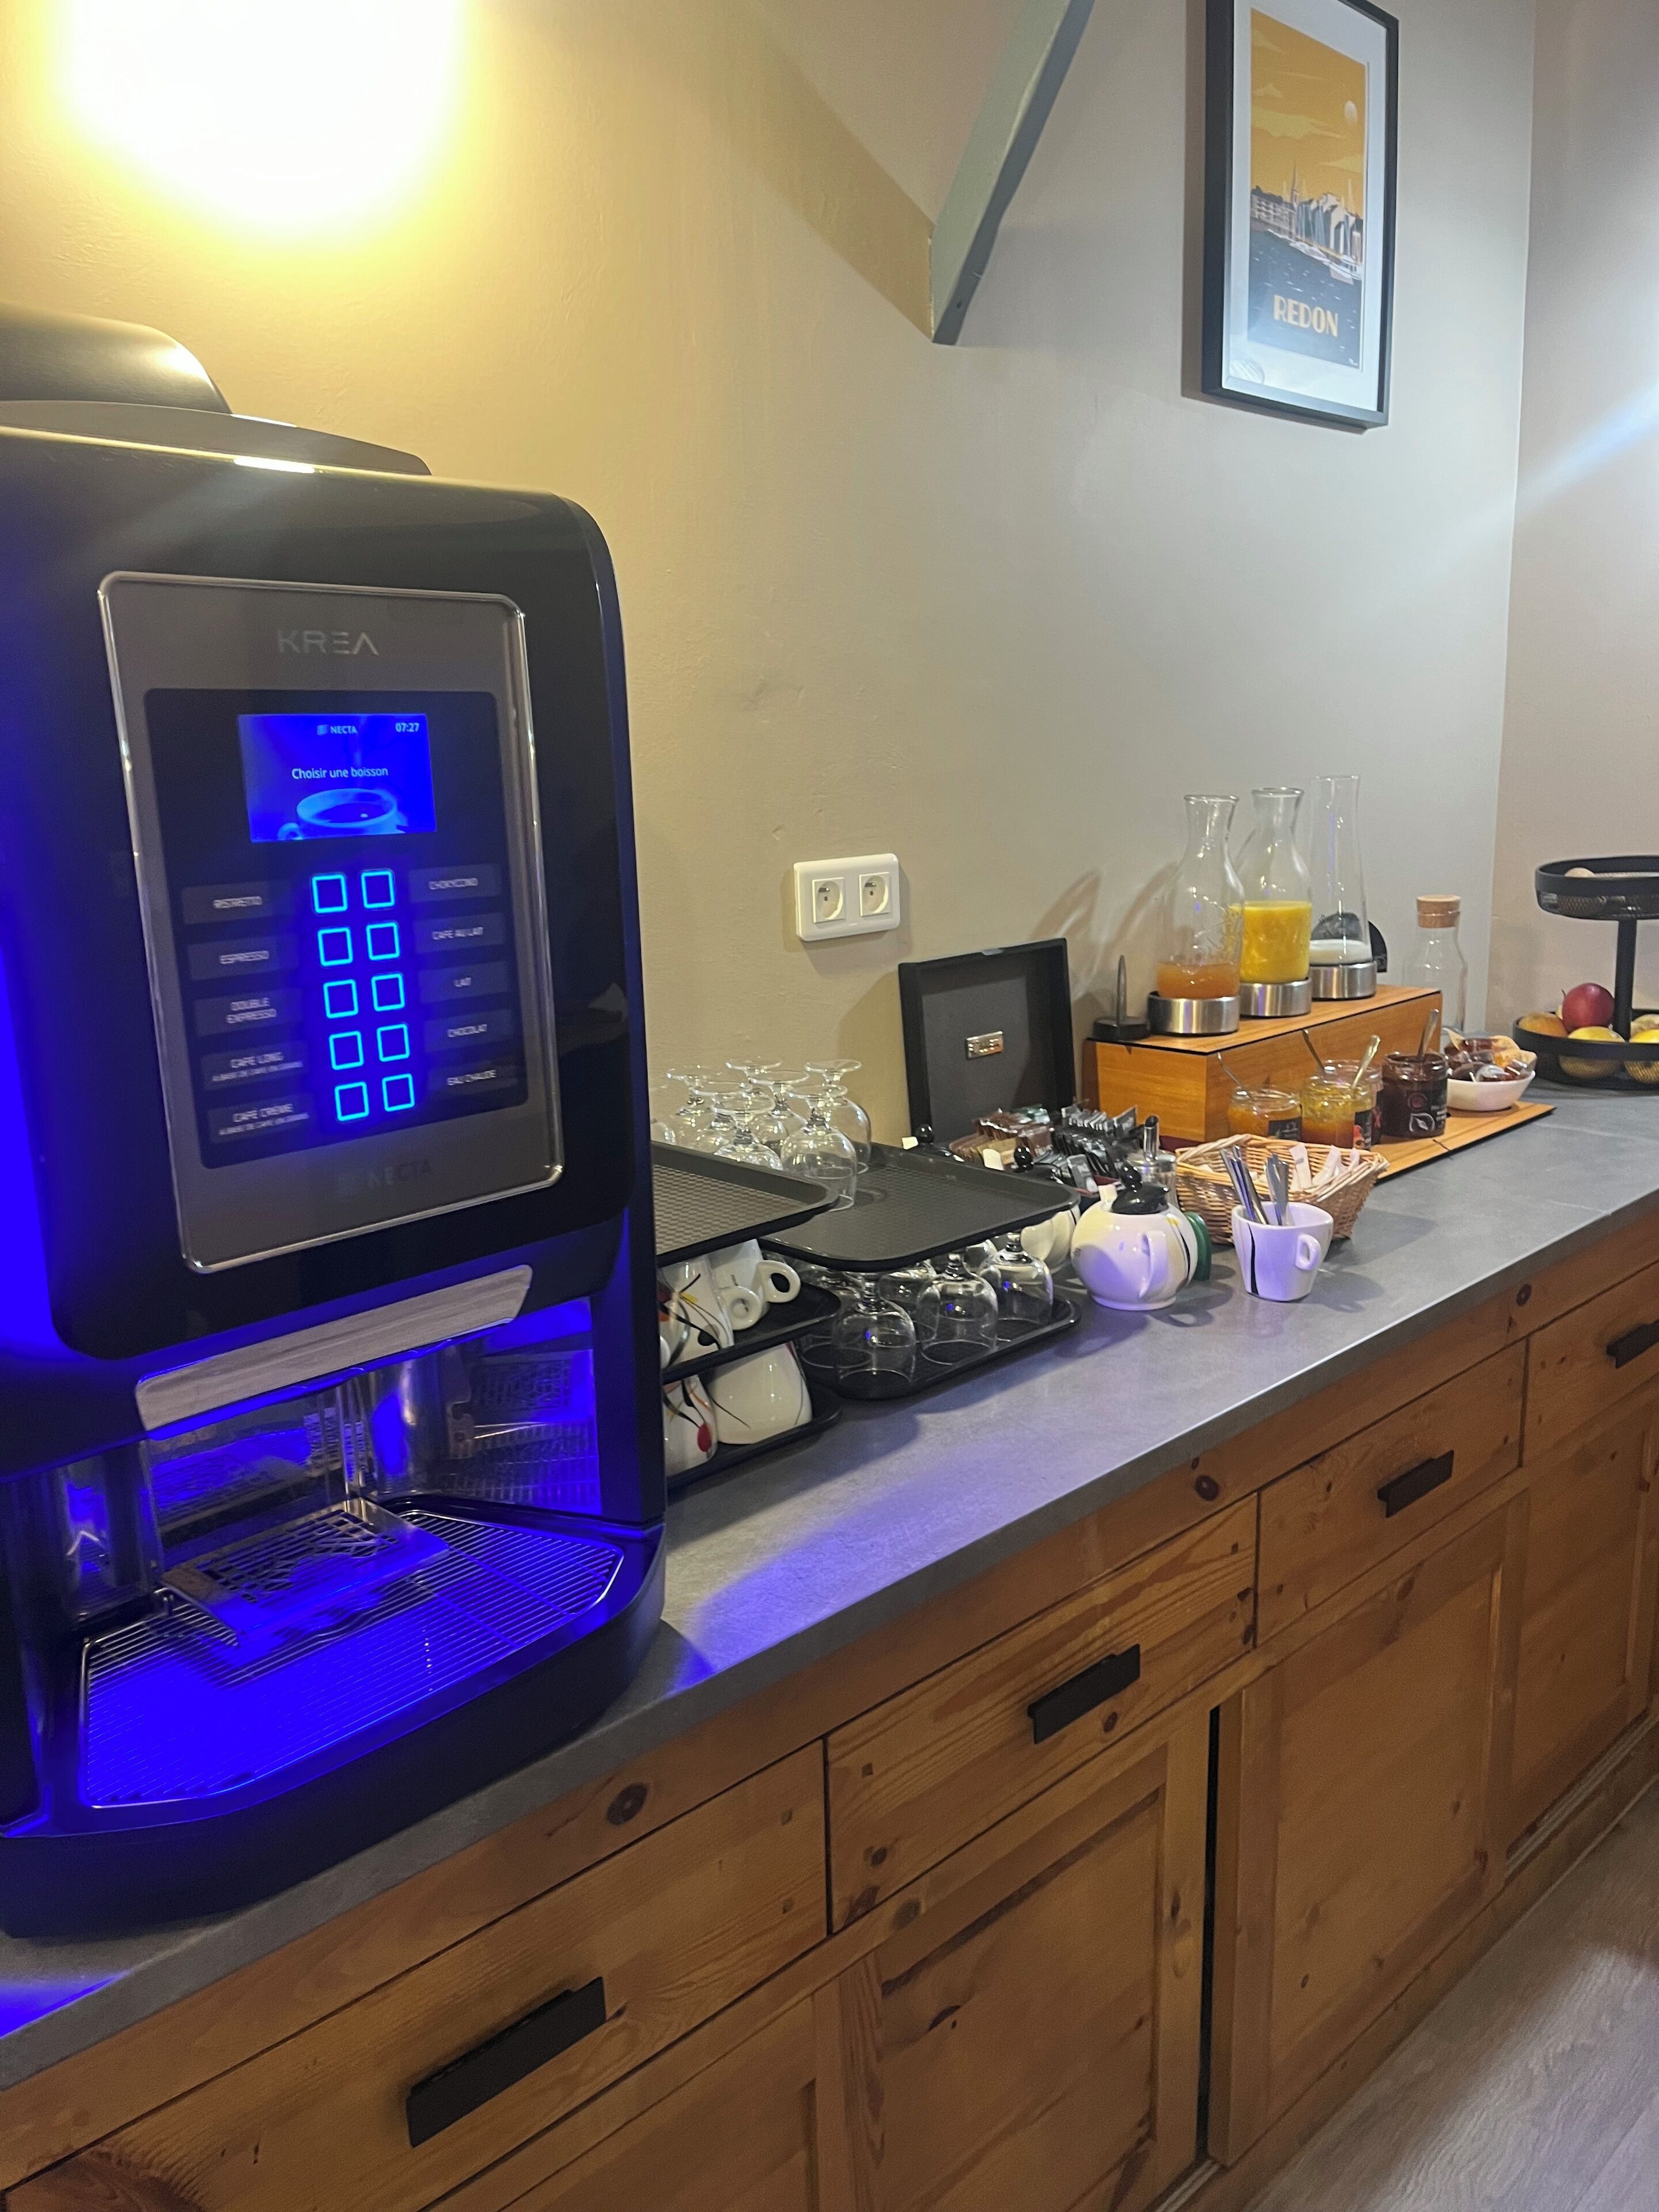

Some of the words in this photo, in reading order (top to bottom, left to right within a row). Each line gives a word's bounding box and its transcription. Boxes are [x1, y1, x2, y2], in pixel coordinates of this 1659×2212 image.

[1274, 294, 1339, 337] REDON
[278, 630, 380, 655] KREA
[331, 726, 357, 734] NECTA
[395, 722, 419, 732] 07:27
[291, 768, 327, 779] Choisir
[329, 769, 349, 778] une
[351, 767, 389, 777] boisson
